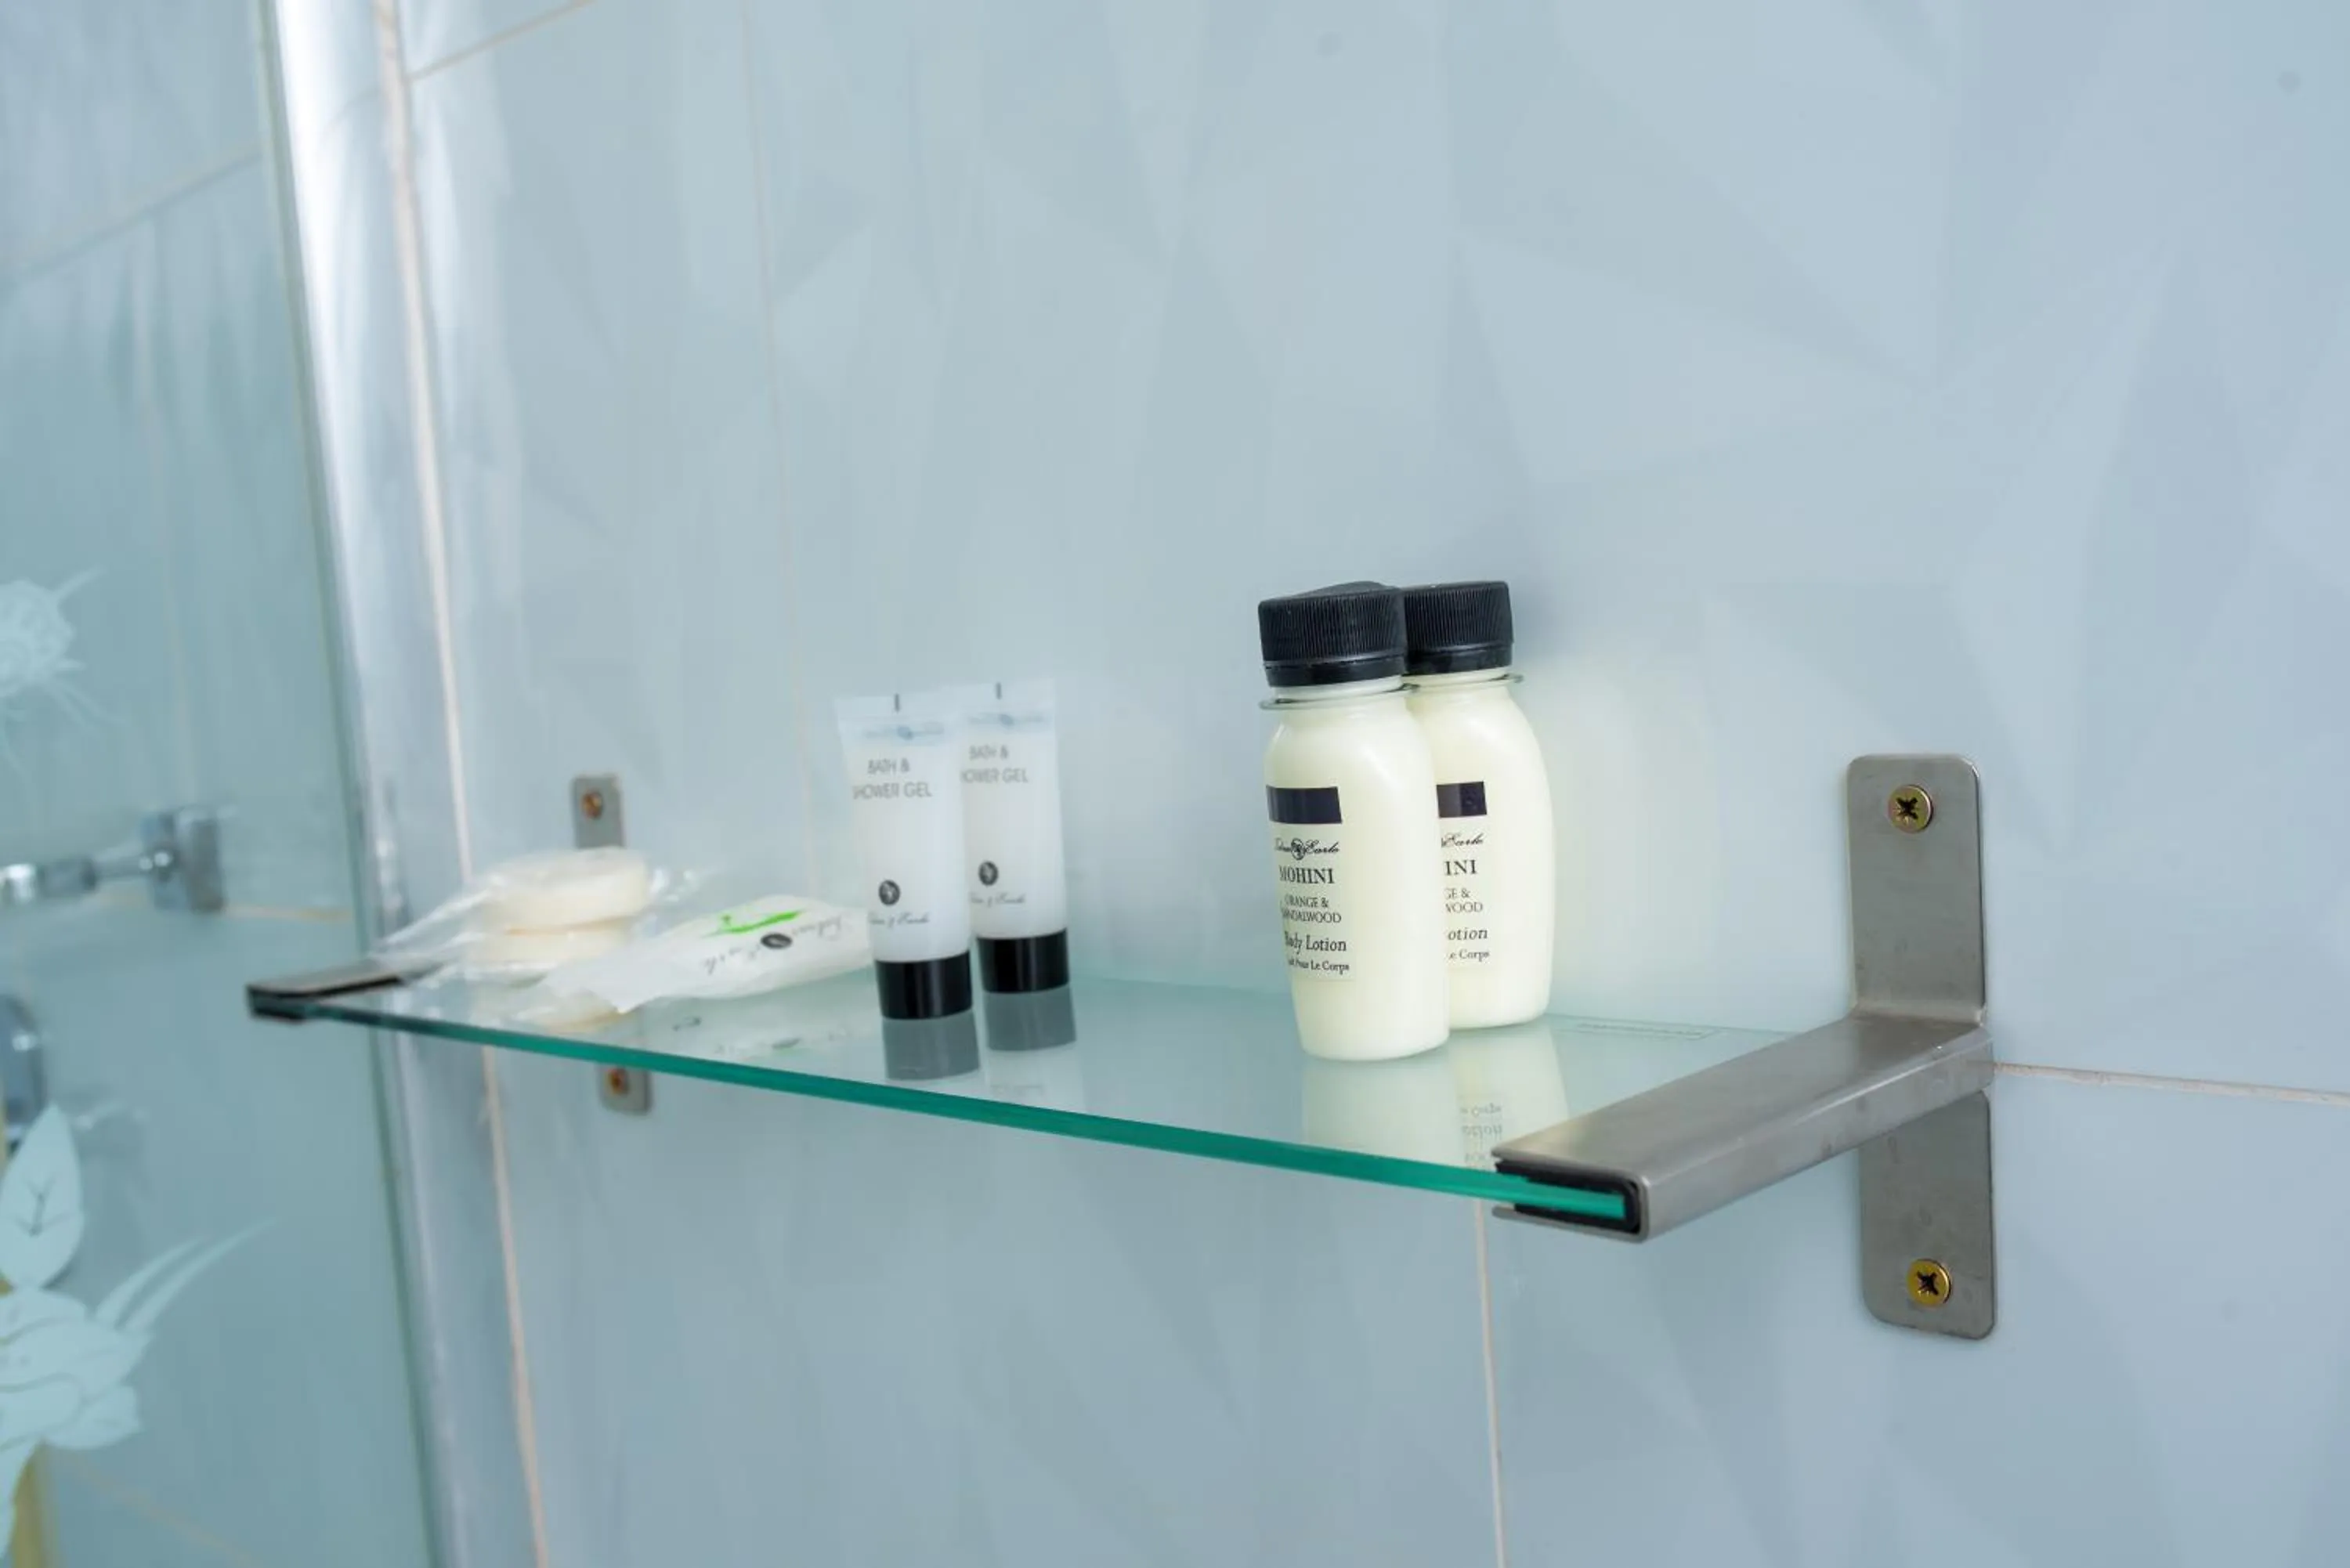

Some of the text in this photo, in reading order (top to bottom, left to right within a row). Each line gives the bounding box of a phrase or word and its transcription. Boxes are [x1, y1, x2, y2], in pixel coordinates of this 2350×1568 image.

[902, 781, 933, 798] GEL
[1278, 865, 1336, 884] MOHINI
[1444, 858, 1477, 876] INI
[1305, 933, 1347, 952] Lotion
[1448, 927, 1488, 941] otion
